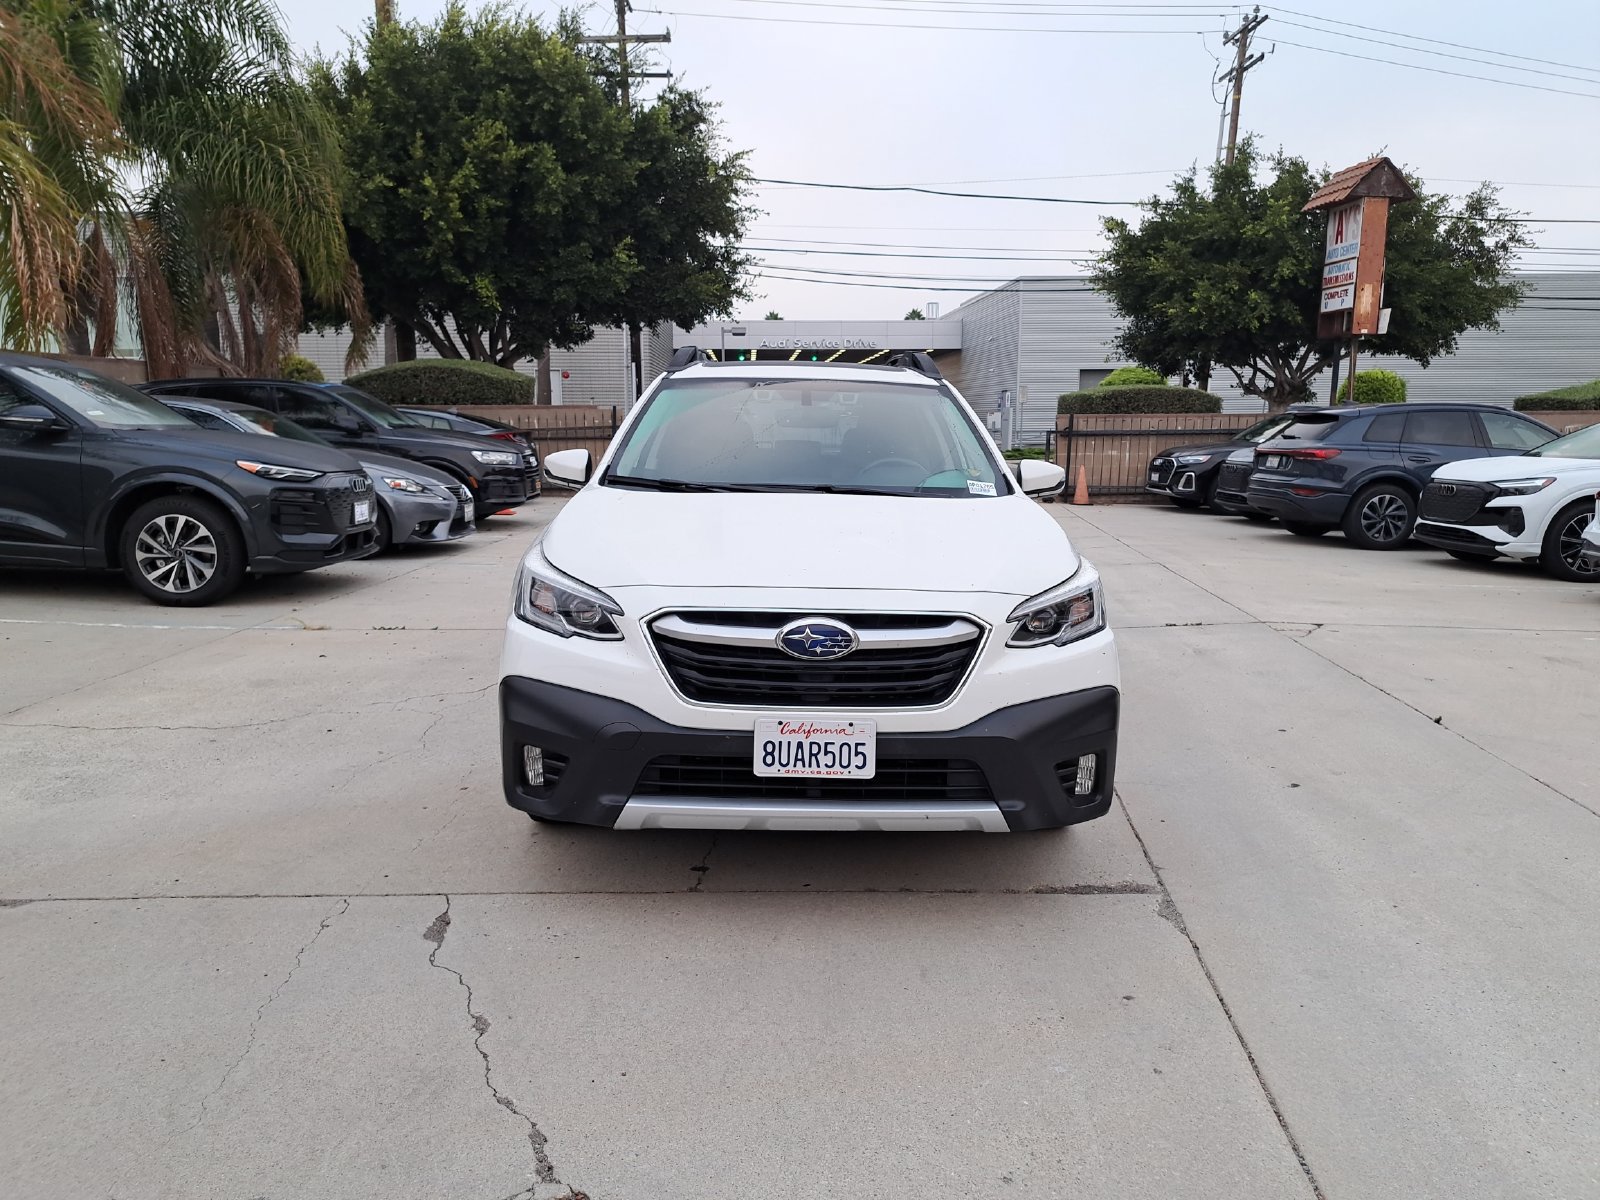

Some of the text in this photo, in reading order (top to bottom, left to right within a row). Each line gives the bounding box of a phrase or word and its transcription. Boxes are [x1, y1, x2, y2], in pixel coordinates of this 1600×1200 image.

[1327, 242, 1358, 260] AUTO CENTER
[1323, 271, 1355, 286] TRANSMISSIONS
[1323, 288, 1349, 301] COMPLETE
[760, 338, 877, 348] Audi Service Drive
[780, 721, 854, 739] California
[762, 740, 867, 770] 8UAR505
